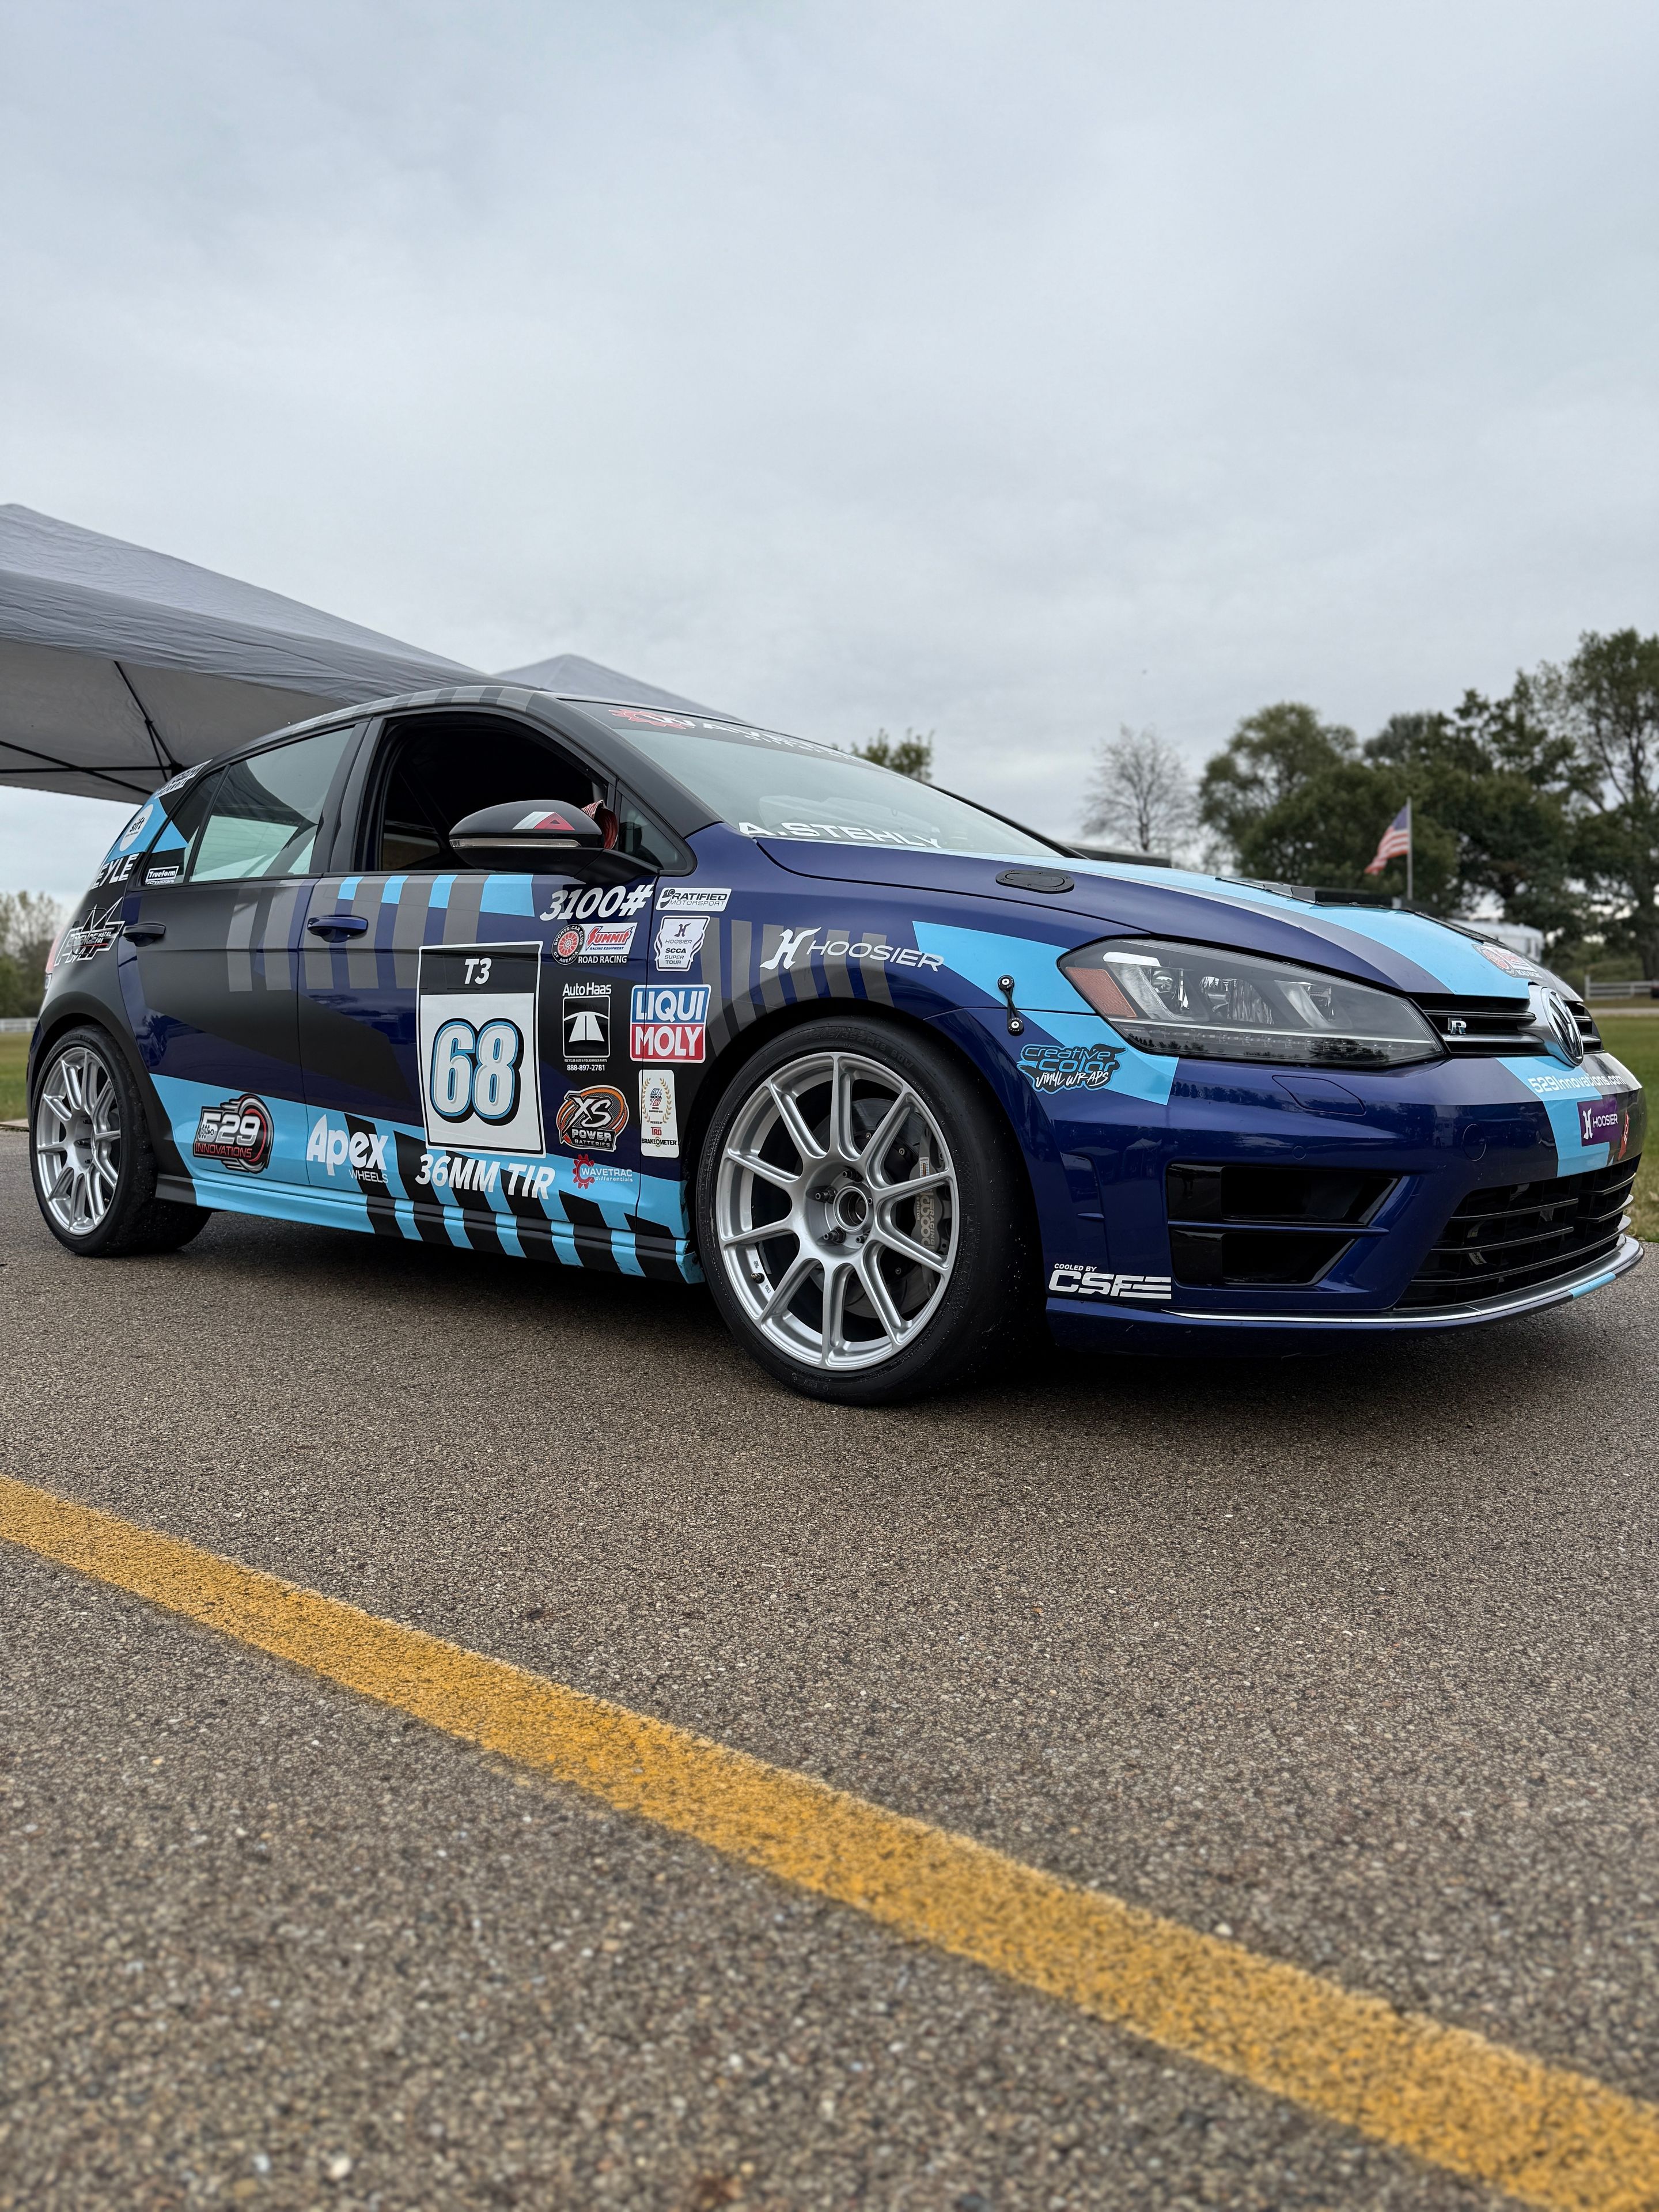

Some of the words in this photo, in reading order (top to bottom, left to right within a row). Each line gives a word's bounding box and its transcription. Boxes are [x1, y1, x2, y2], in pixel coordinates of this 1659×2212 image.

[738, 822, 941, 849] A.STEHLY
[540, 884, 654, 922] 3100#
[554, 926, 570, 946] SPORTS
[559, 950, 579, 964] AMERICA
[578, 956, 599, 964] ROAD
[600, 955, 627, 964] RACING
[806, 940, 945, 972] HOOSIER
[464, 957, 491, 985] T3
[562, 983, 586, 997] Auto
[586, 982, 612, 996] Haas
[636, 990, 705, 1022] LIQUI
[635, 1026, 703, 1056] MOLY
[430, 1018, 523, 1126] 68
[198, 1112, 261, 1146] 529
[571, 1128, 612, 1142] POWER
[195, 1141, 253, 1160] INNOVATIONS
[306, 1114, 389, 1176] Apex
[574, 1138, 611, 1147] BATTERIES
[348, 1169, 389, 1184] WHEELS
[415, 1154, 501, 1193] 36MM
[507, 1164, 555, 1200] TIR
[581, 1168, 632, 1177] WAVETRAC
[1054, 1263, 1084, 1271] COOLED
